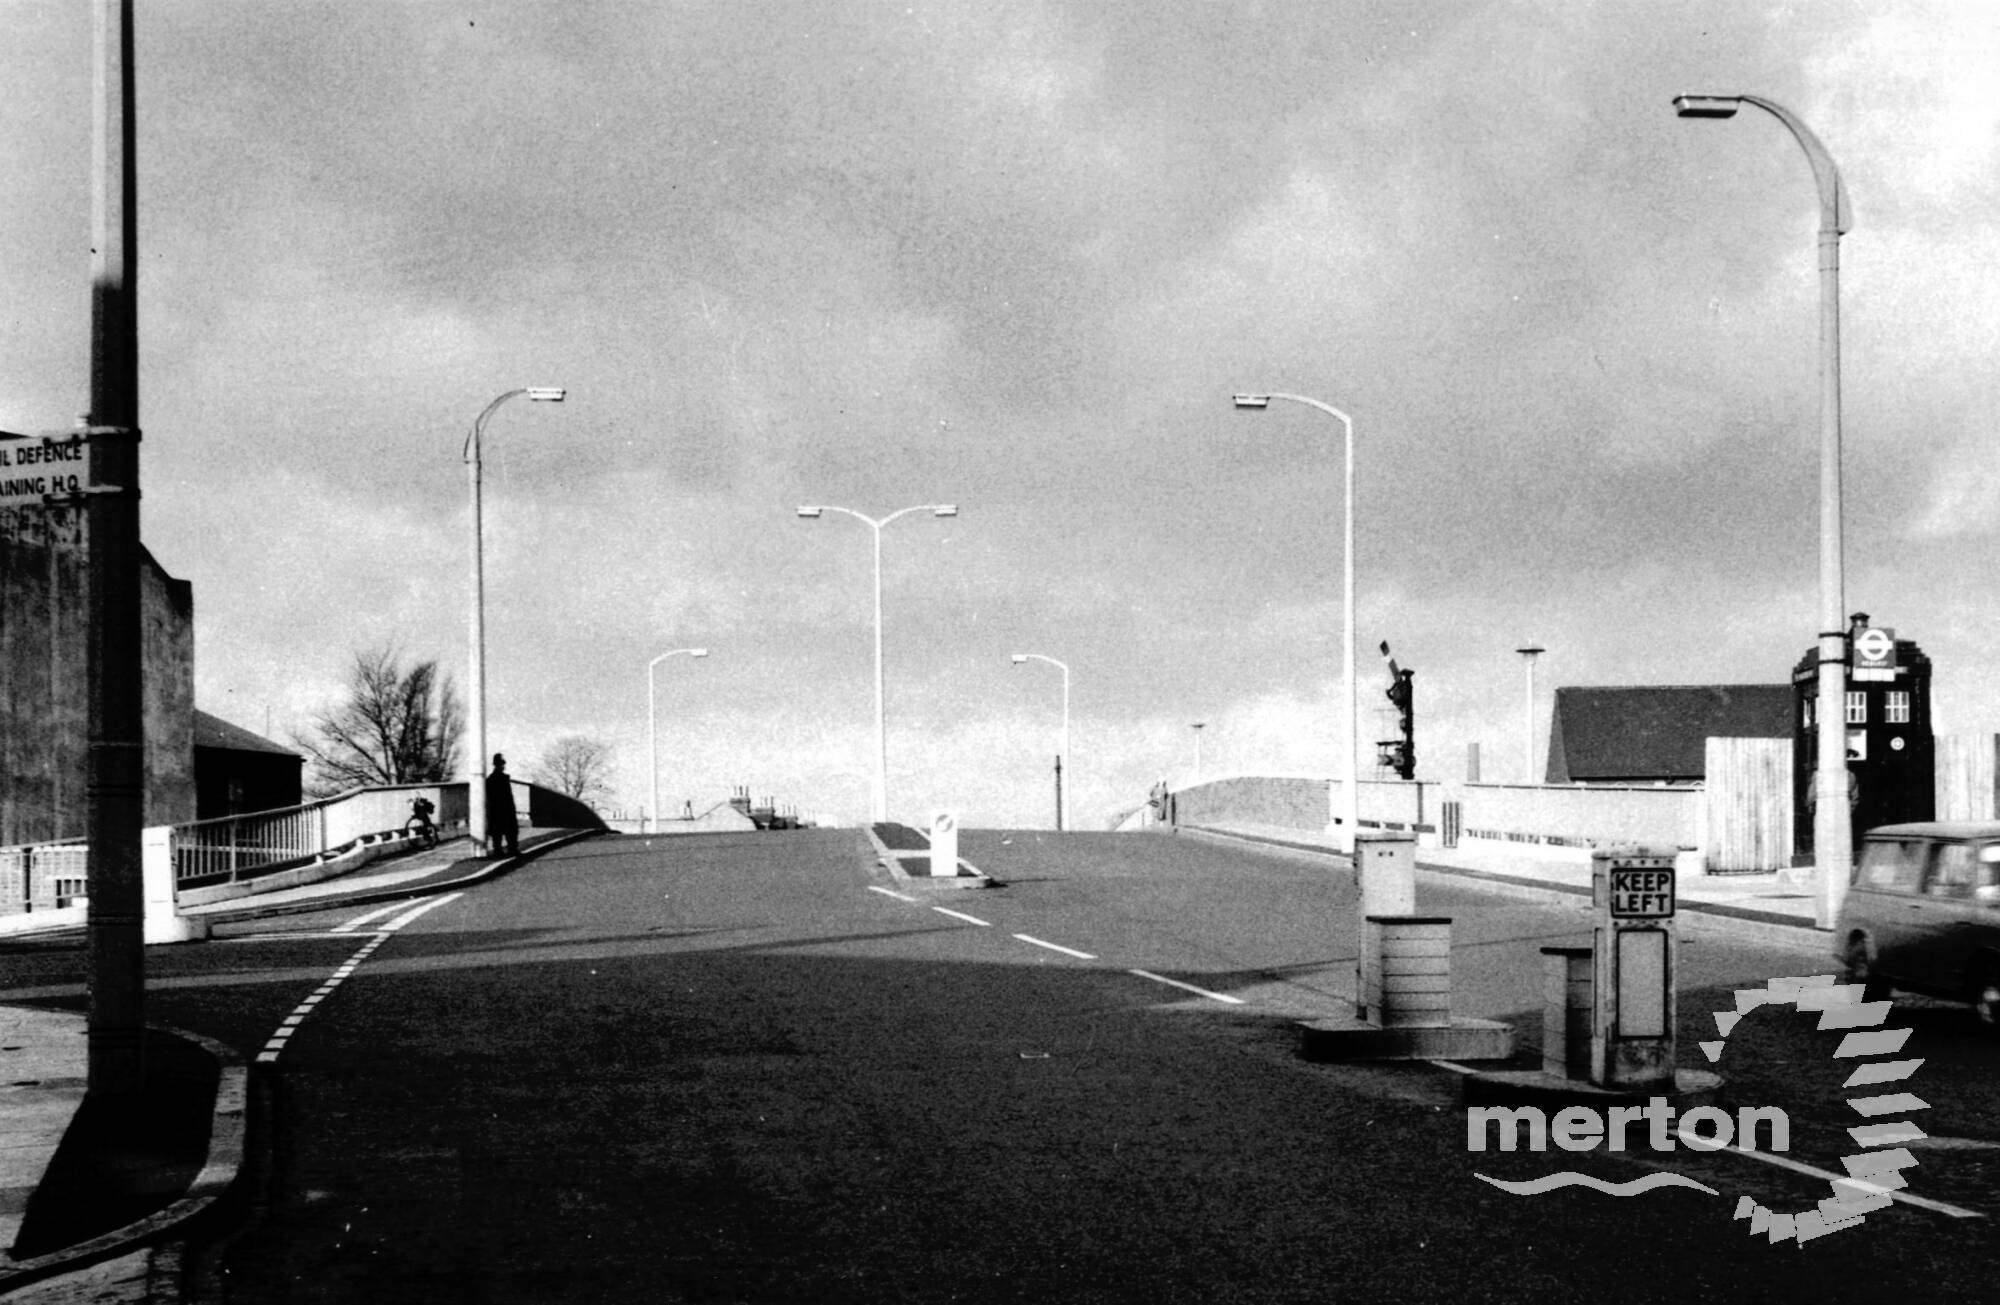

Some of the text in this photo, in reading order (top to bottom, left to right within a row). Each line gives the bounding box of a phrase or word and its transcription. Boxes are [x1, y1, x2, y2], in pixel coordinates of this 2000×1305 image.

[17, 444, 82, 465] DEFENCE
[1615, 873, 1669, 892] KEEP
[1615, 894, 1669, 912] LEFT
